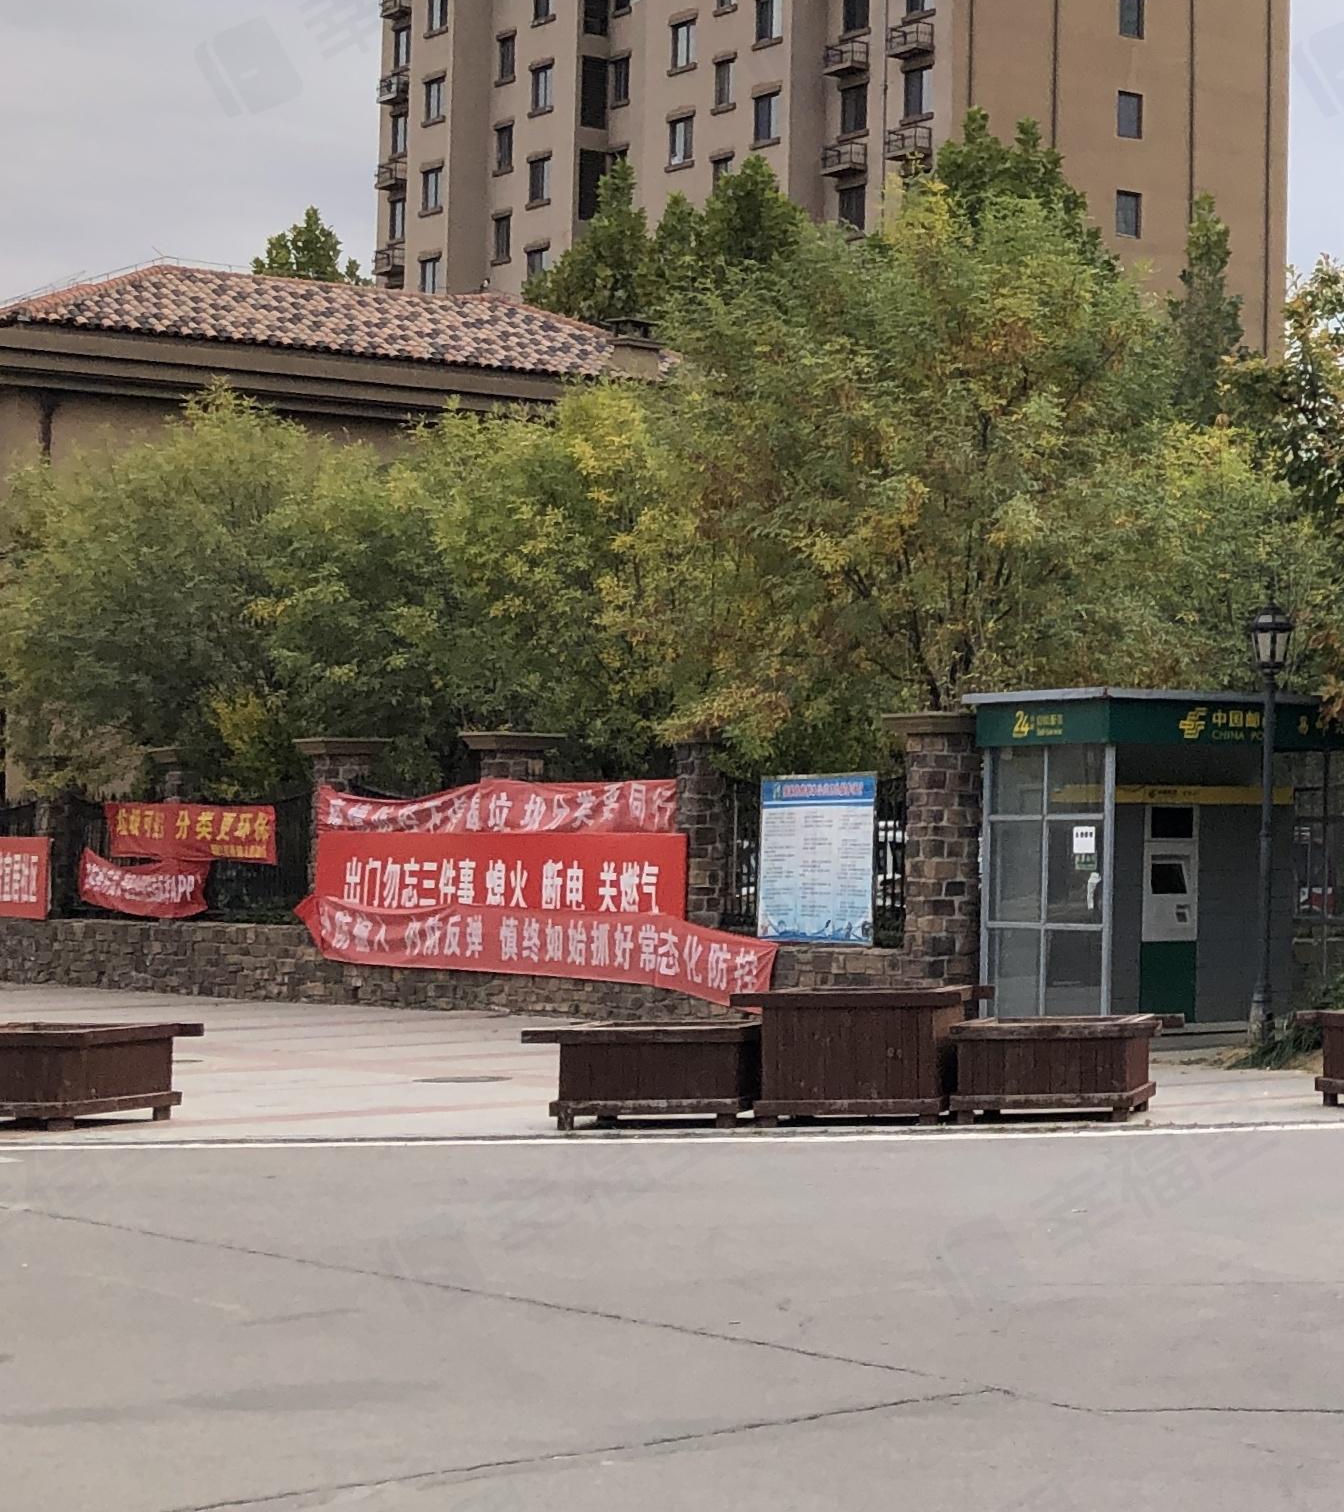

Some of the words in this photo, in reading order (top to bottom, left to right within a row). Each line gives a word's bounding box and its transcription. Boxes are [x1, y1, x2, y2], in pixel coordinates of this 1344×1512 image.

[1012, 710, 1031, 737] 24
[1212, 730, 1245, 741] CHINA
[176, 809, 269, 841] 分类更环保
[344, 856, 476, 908] 出门勿忘三件事
[486, 859, 528, 908] 熄火
[542, 859, 585, 910] 断电
[599, 861, 660, 914] 关燃气
